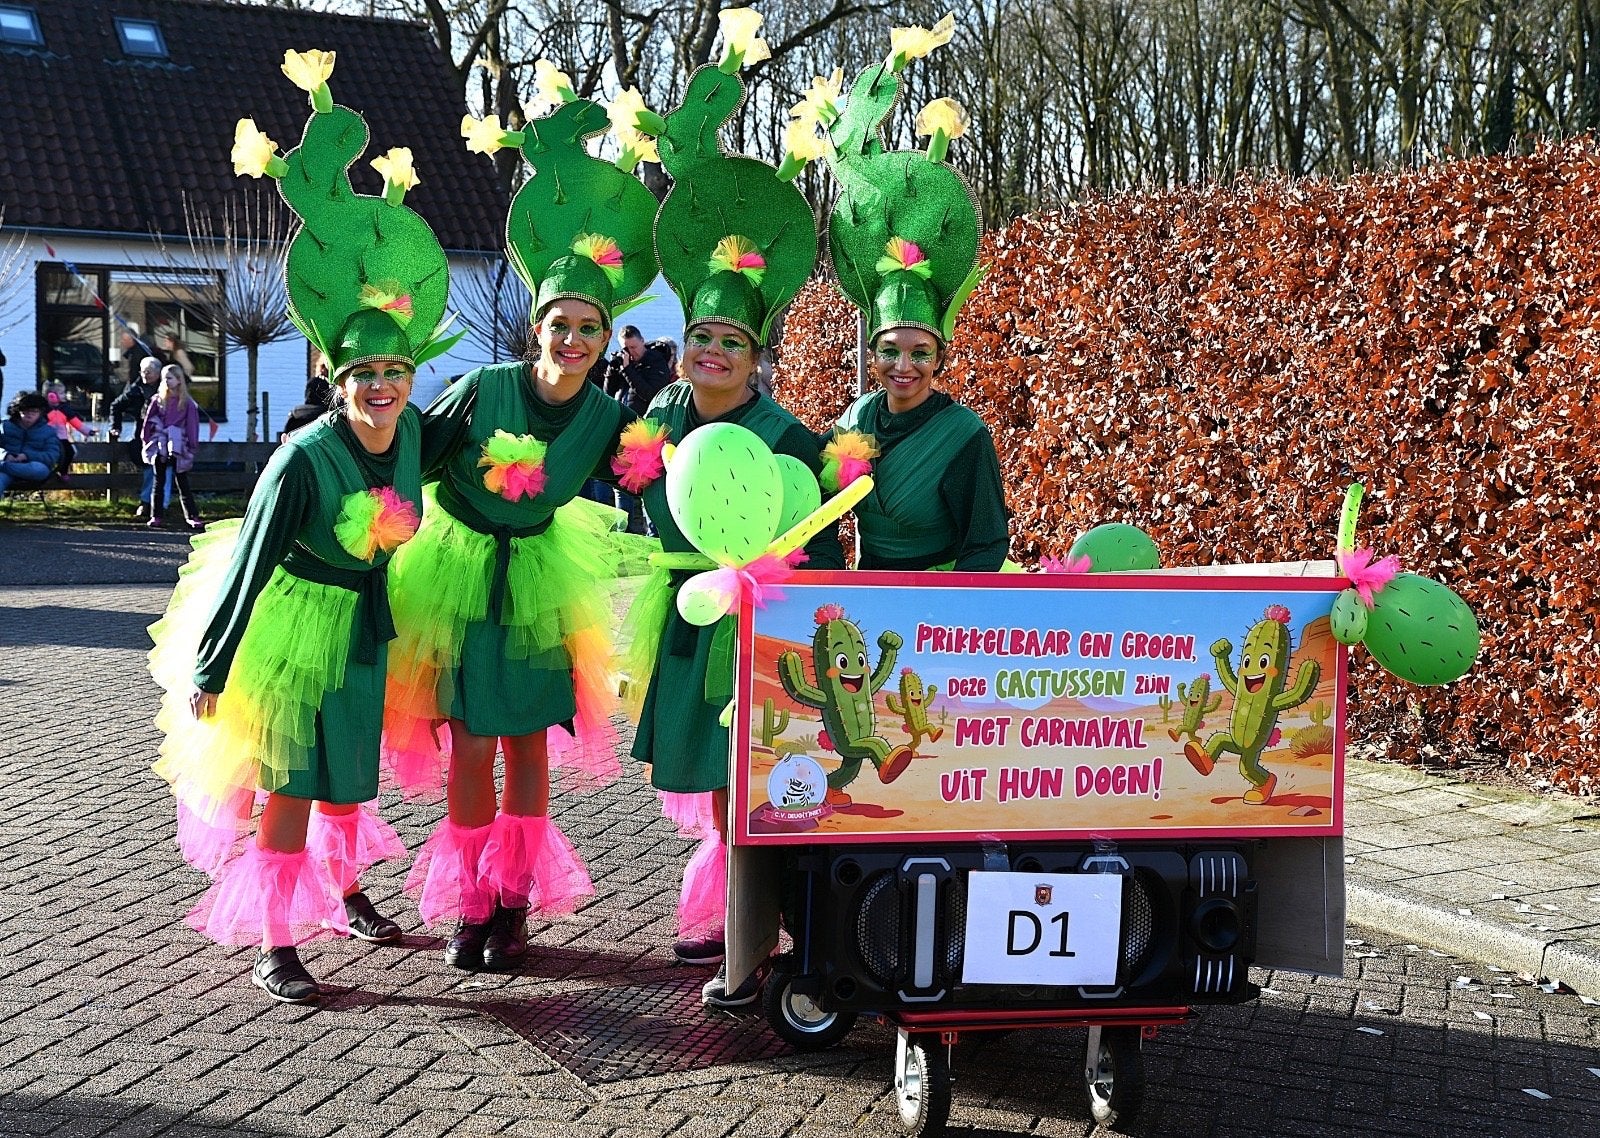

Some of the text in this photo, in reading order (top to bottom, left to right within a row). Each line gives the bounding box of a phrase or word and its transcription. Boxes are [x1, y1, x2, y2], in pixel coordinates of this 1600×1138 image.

[1021, 716, 1147, 748] CARNAVAL
[1000, 767, 1063, 802] HUN
[774, 811, 787, 819] C.V.
[1007, 910, 1076, 957] D1
